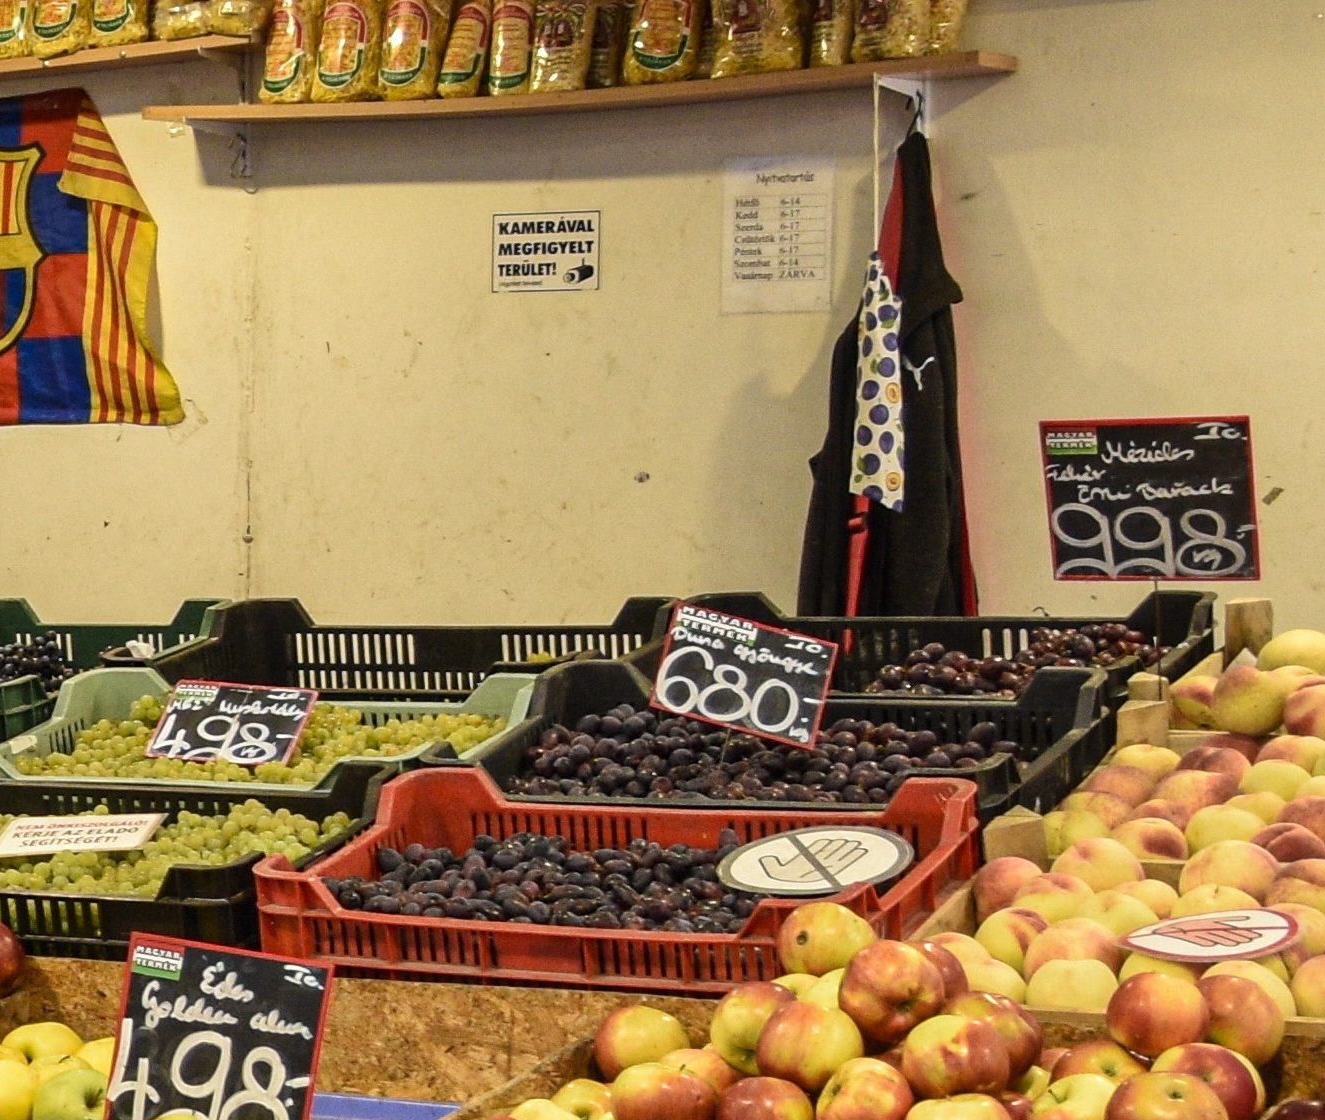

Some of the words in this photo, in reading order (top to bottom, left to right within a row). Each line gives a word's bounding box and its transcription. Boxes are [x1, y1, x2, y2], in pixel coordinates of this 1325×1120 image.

[498, 216, 595, 235] KAMERÁVAL
[498, 240, 595, 256] MEGFIGYELT
[498, 259, 557, 277] TERÜLET!
[682, 606, 754, 631] MAGYAR
[136, 945, 180, 959] MAGYAR
[135, 958, 179, 971] TERMÉK
